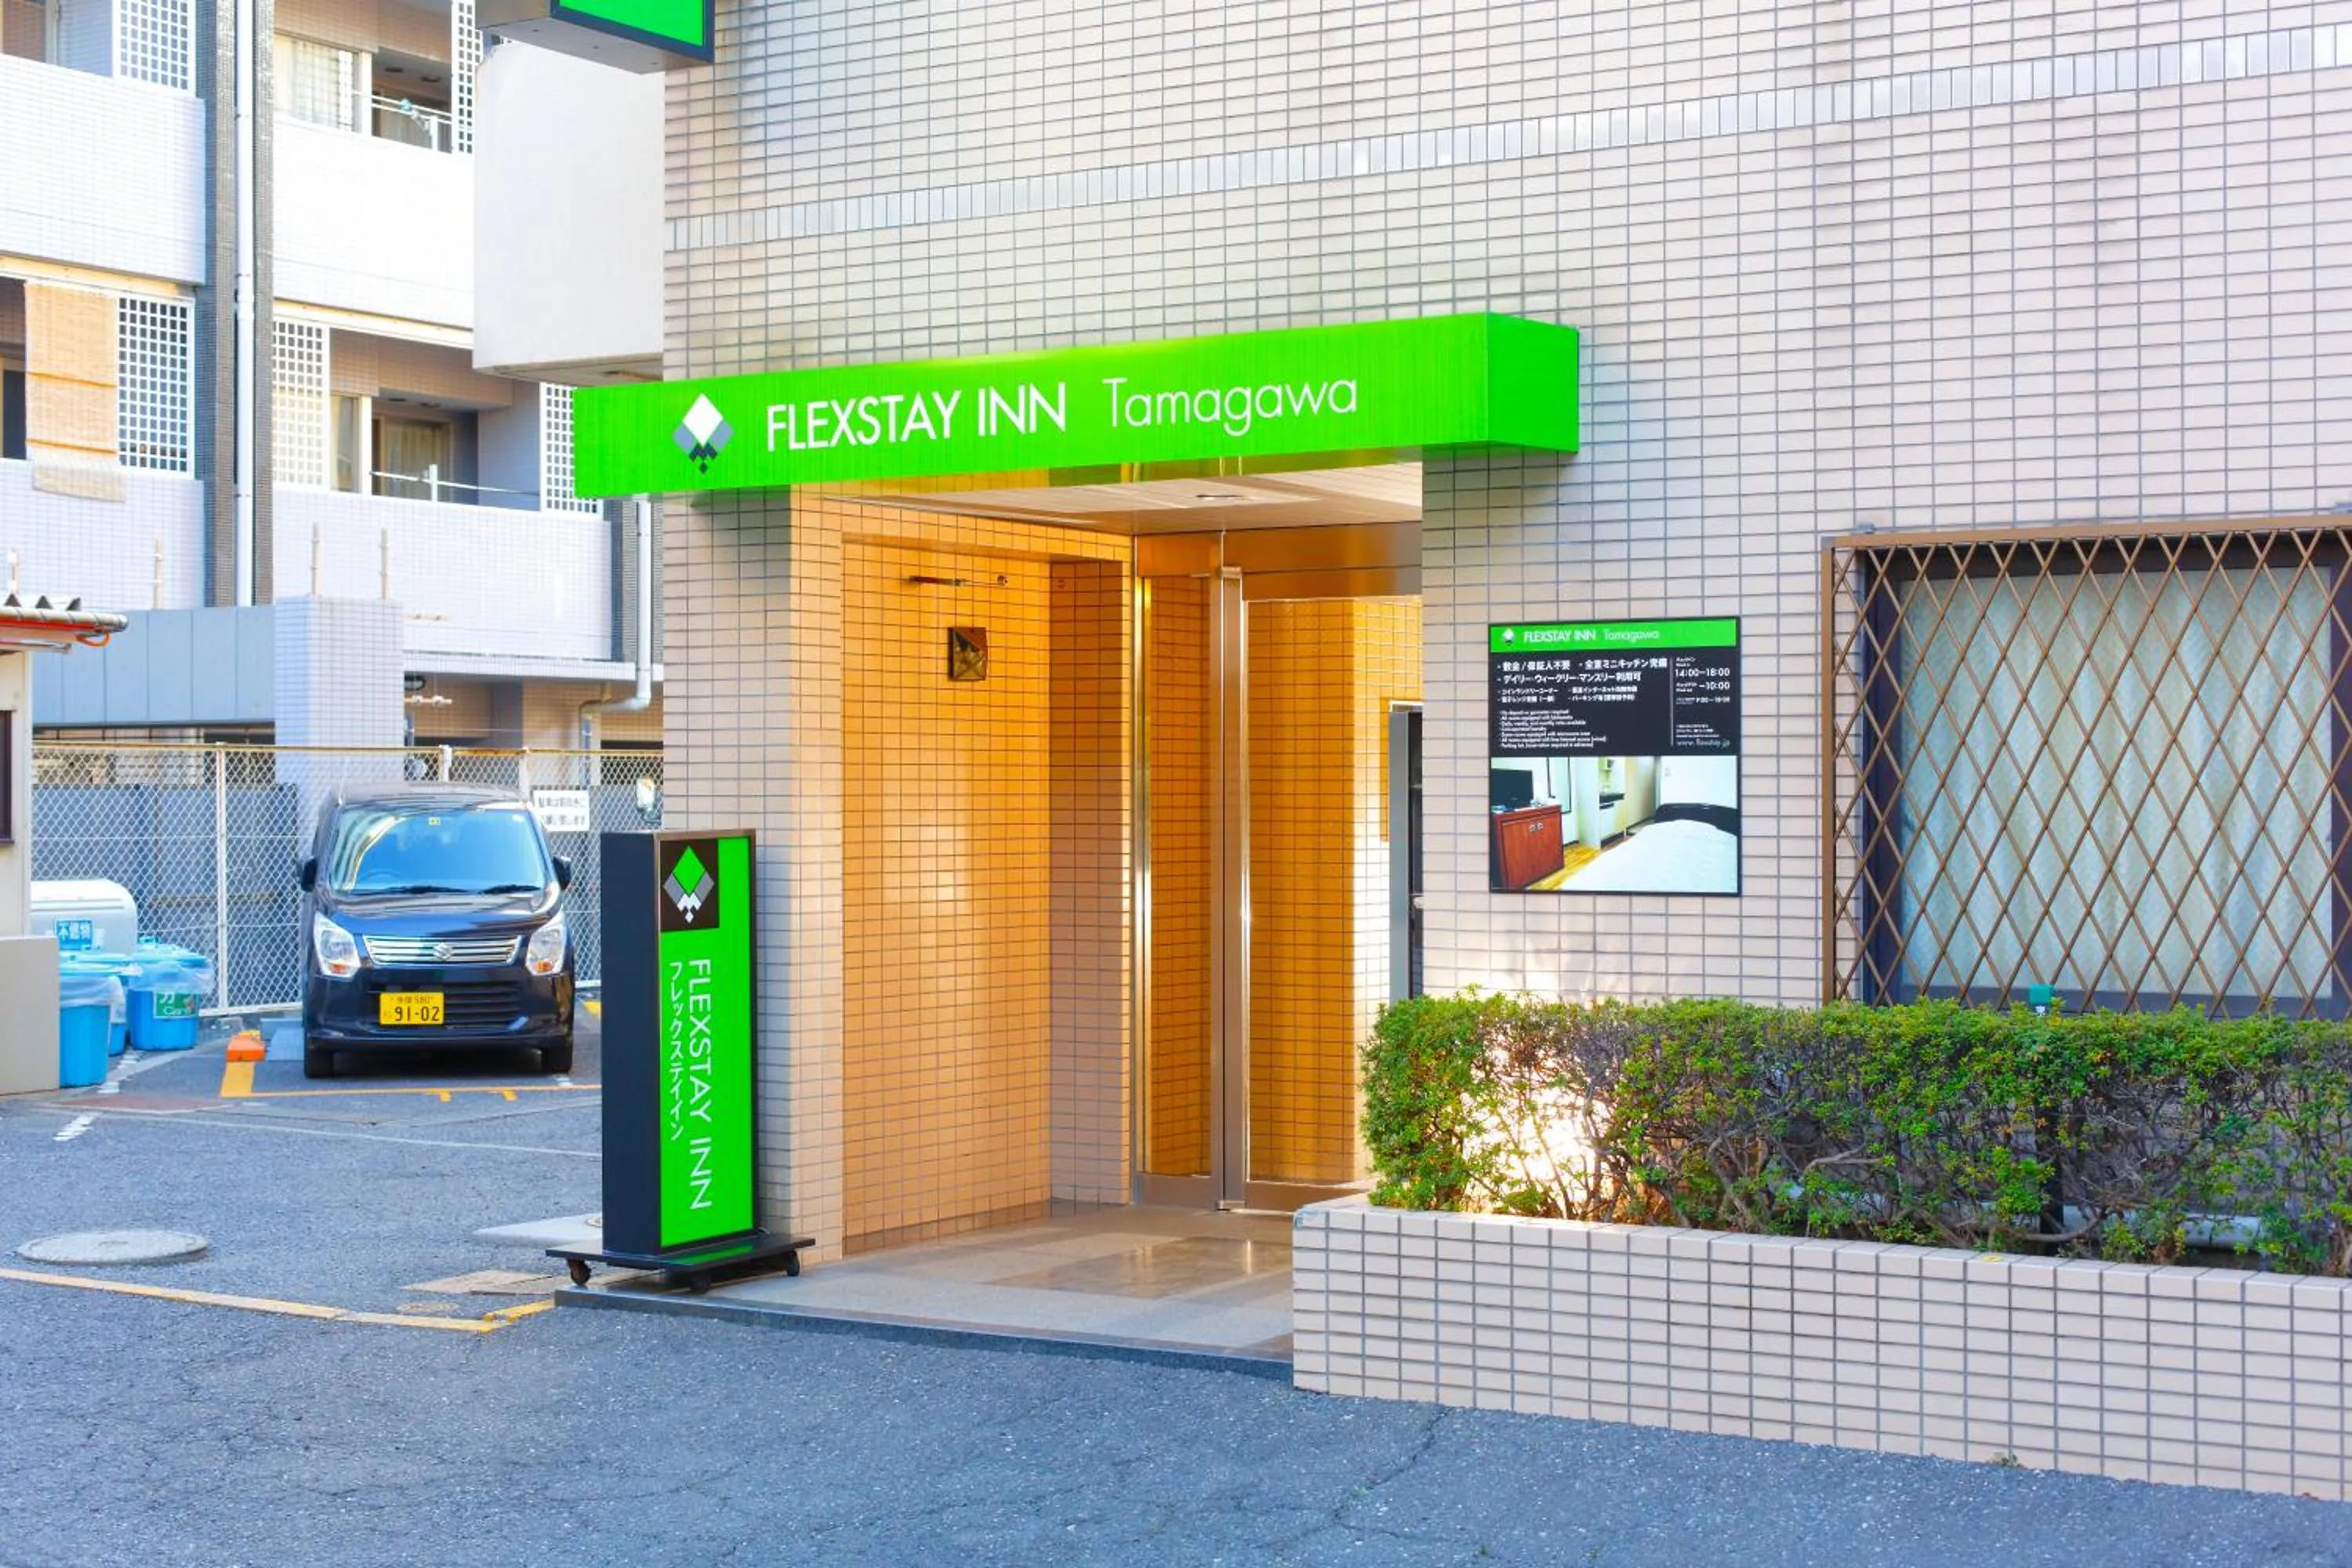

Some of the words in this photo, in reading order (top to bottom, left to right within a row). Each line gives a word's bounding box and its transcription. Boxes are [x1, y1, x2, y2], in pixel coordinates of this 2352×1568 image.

[767, 390, 962, 452] FLEXSTAY
[977, 383, 1067, 437] INN
[1102, 376, 1357, 437] Tamagawa
[1523, 630, 1571, 643] FLEXSTAY
[1573, 629, 1596, 641] INN
[1603, 628, 1660, 644] Tamagawa
[394, 1005, 441, 1022] 91-02
[688, 958, 712, 1123] FLEXSTAY
[669, 960, 684, 1142] フレックステイイン
[690, 1137, 712, 1210] INN
